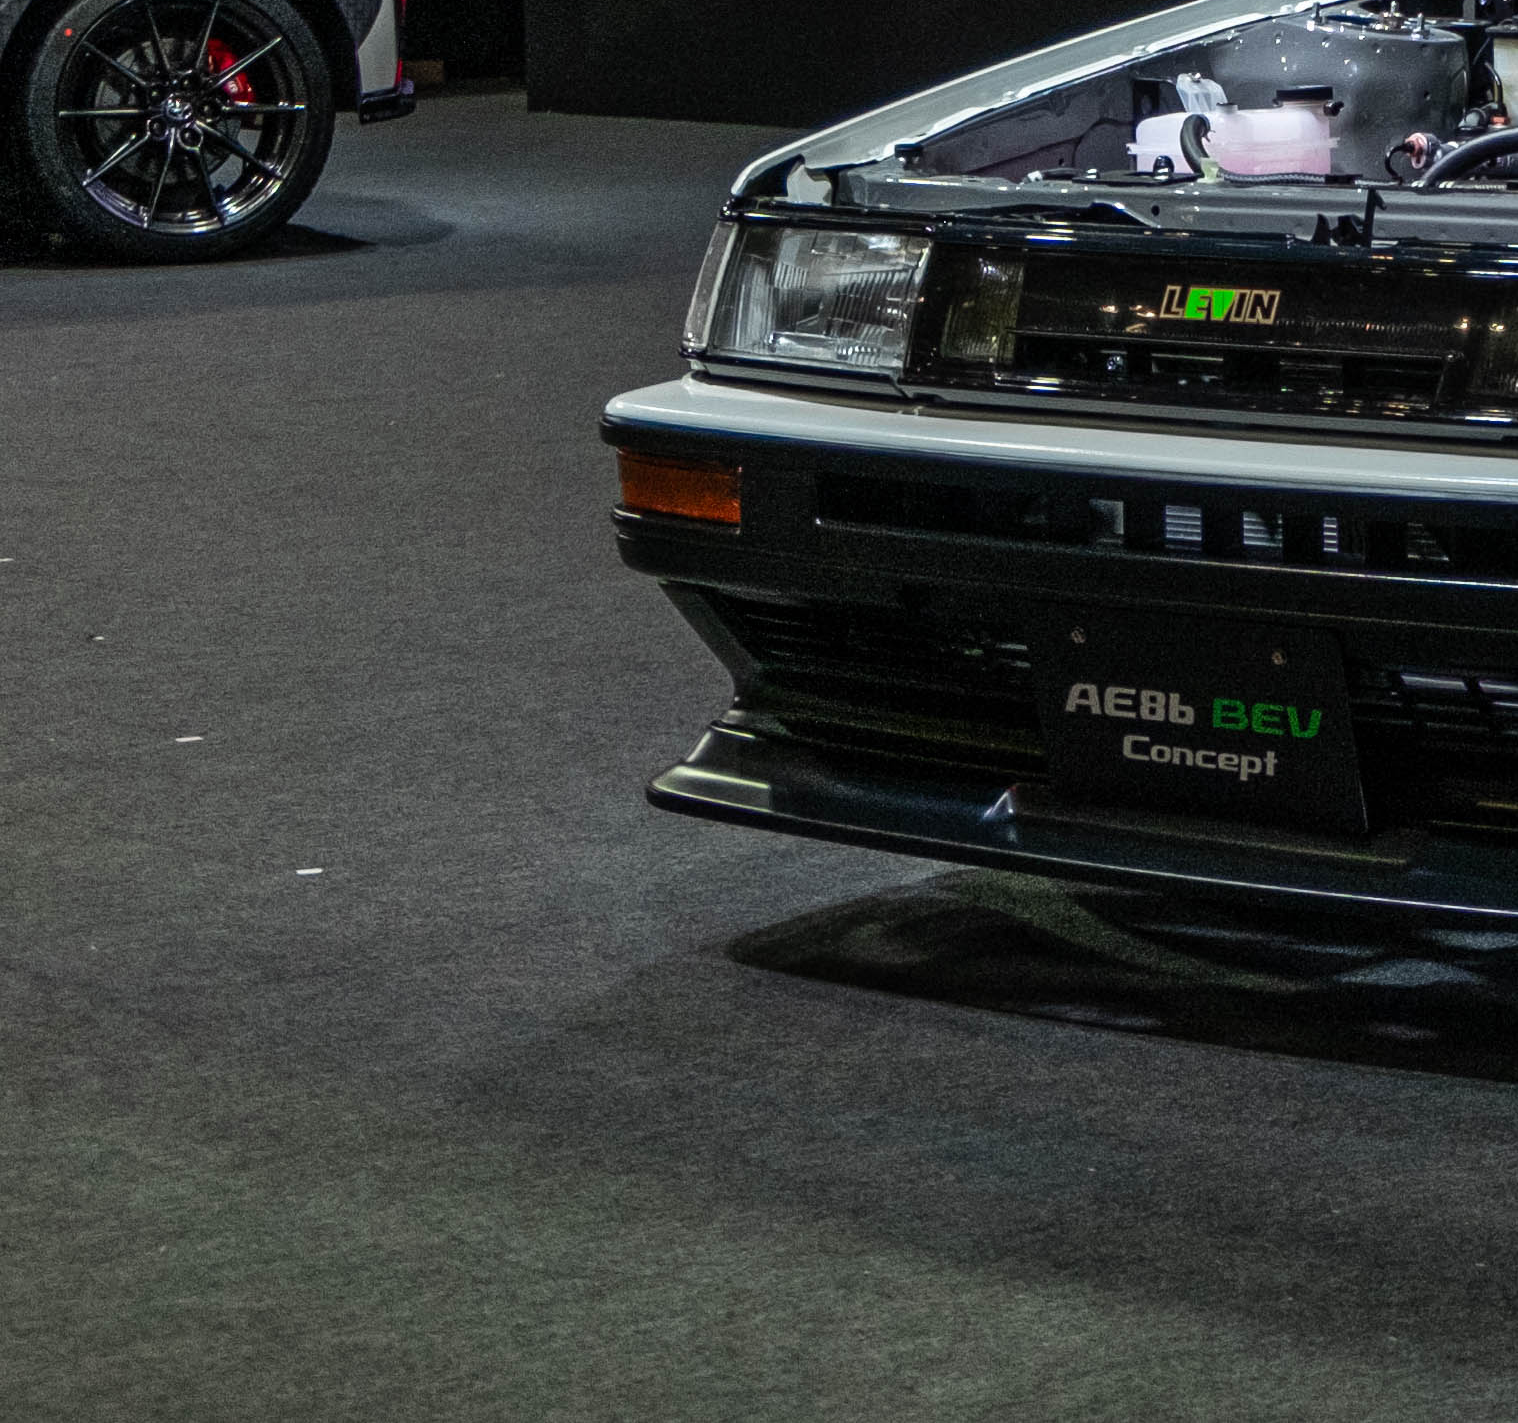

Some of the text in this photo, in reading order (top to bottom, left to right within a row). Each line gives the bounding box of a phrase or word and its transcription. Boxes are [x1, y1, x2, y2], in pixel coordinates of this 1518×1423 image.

[1159, 285, 1281, 325] LEVIN
[1211, 697, 1323, 739] BEV
[1122, 734, 1278, 781] Concept
